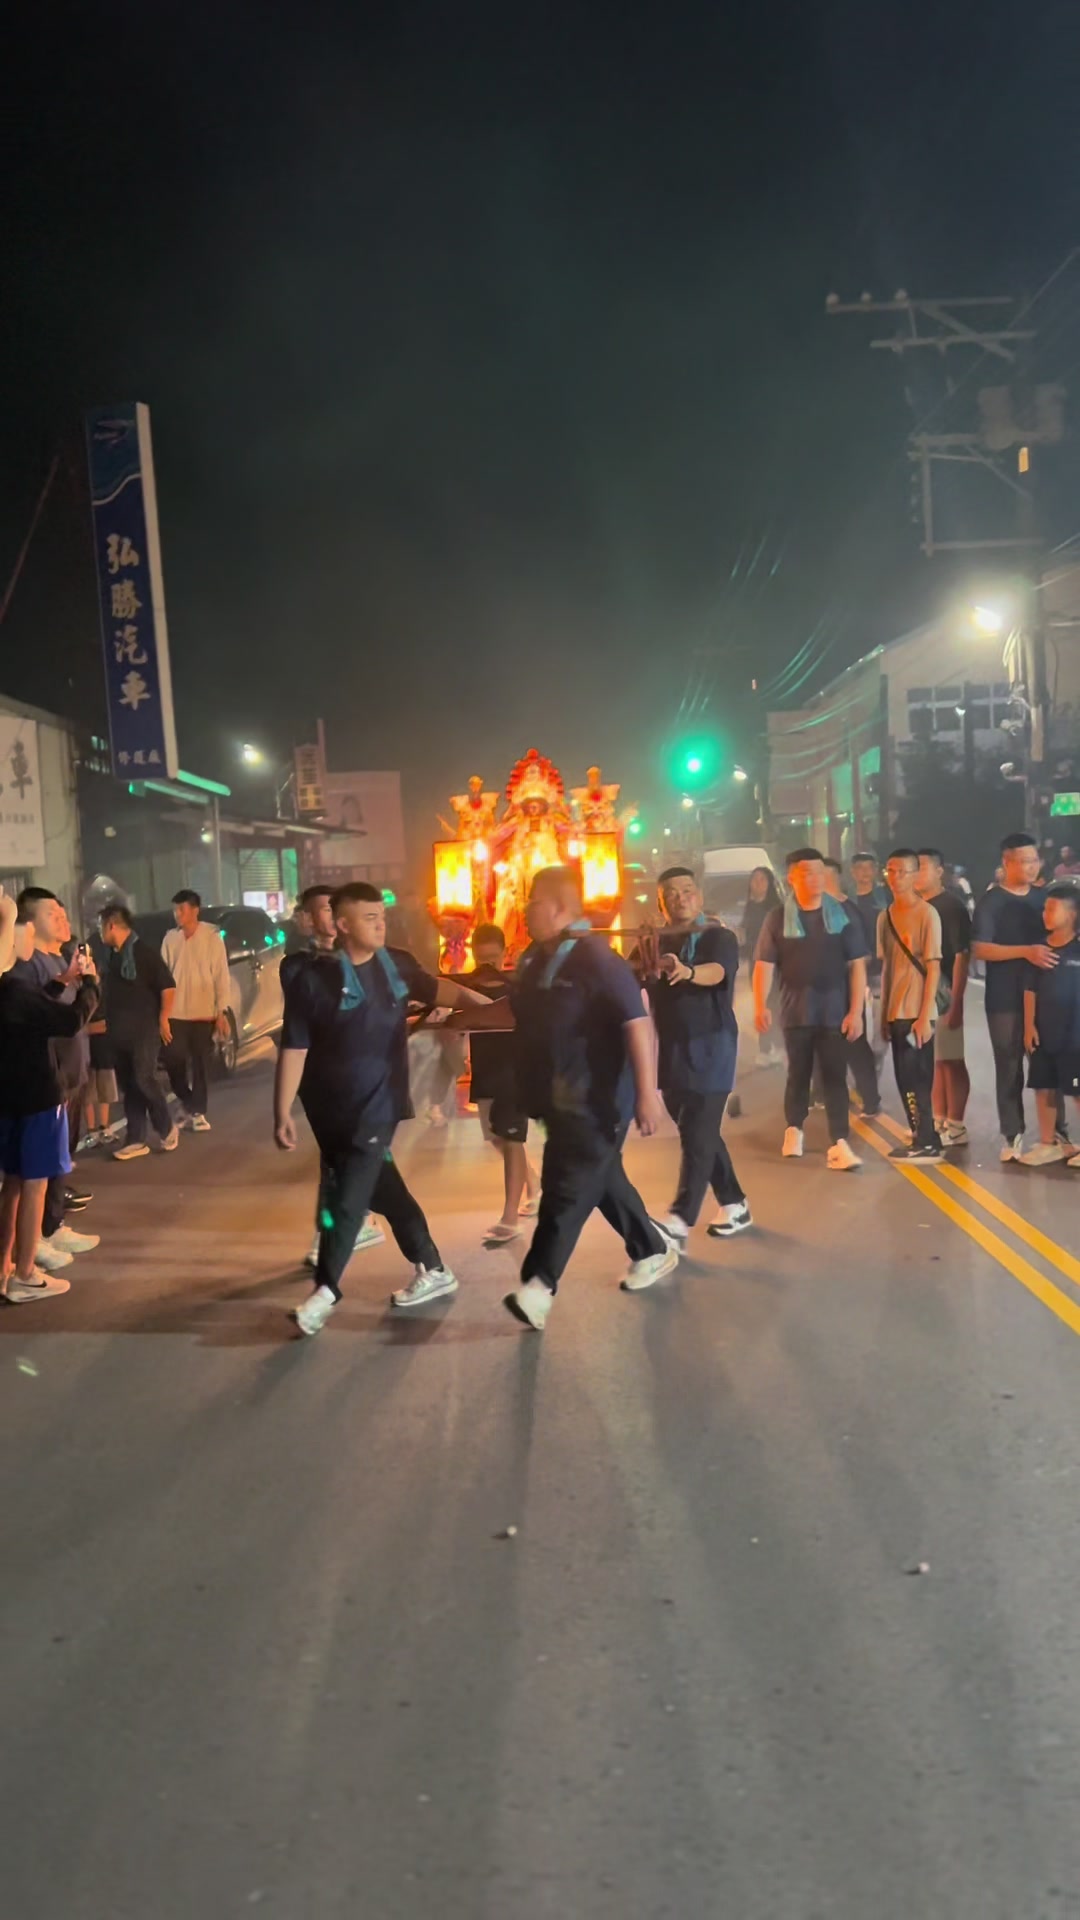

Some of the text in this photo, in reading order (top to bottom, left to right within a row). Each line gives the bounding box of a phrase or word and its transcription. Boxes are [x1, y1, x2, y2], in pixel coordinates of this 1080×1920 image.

[106, 533, 151, 711] 弘勝汽車
[0, 740, 33, 800] 車
